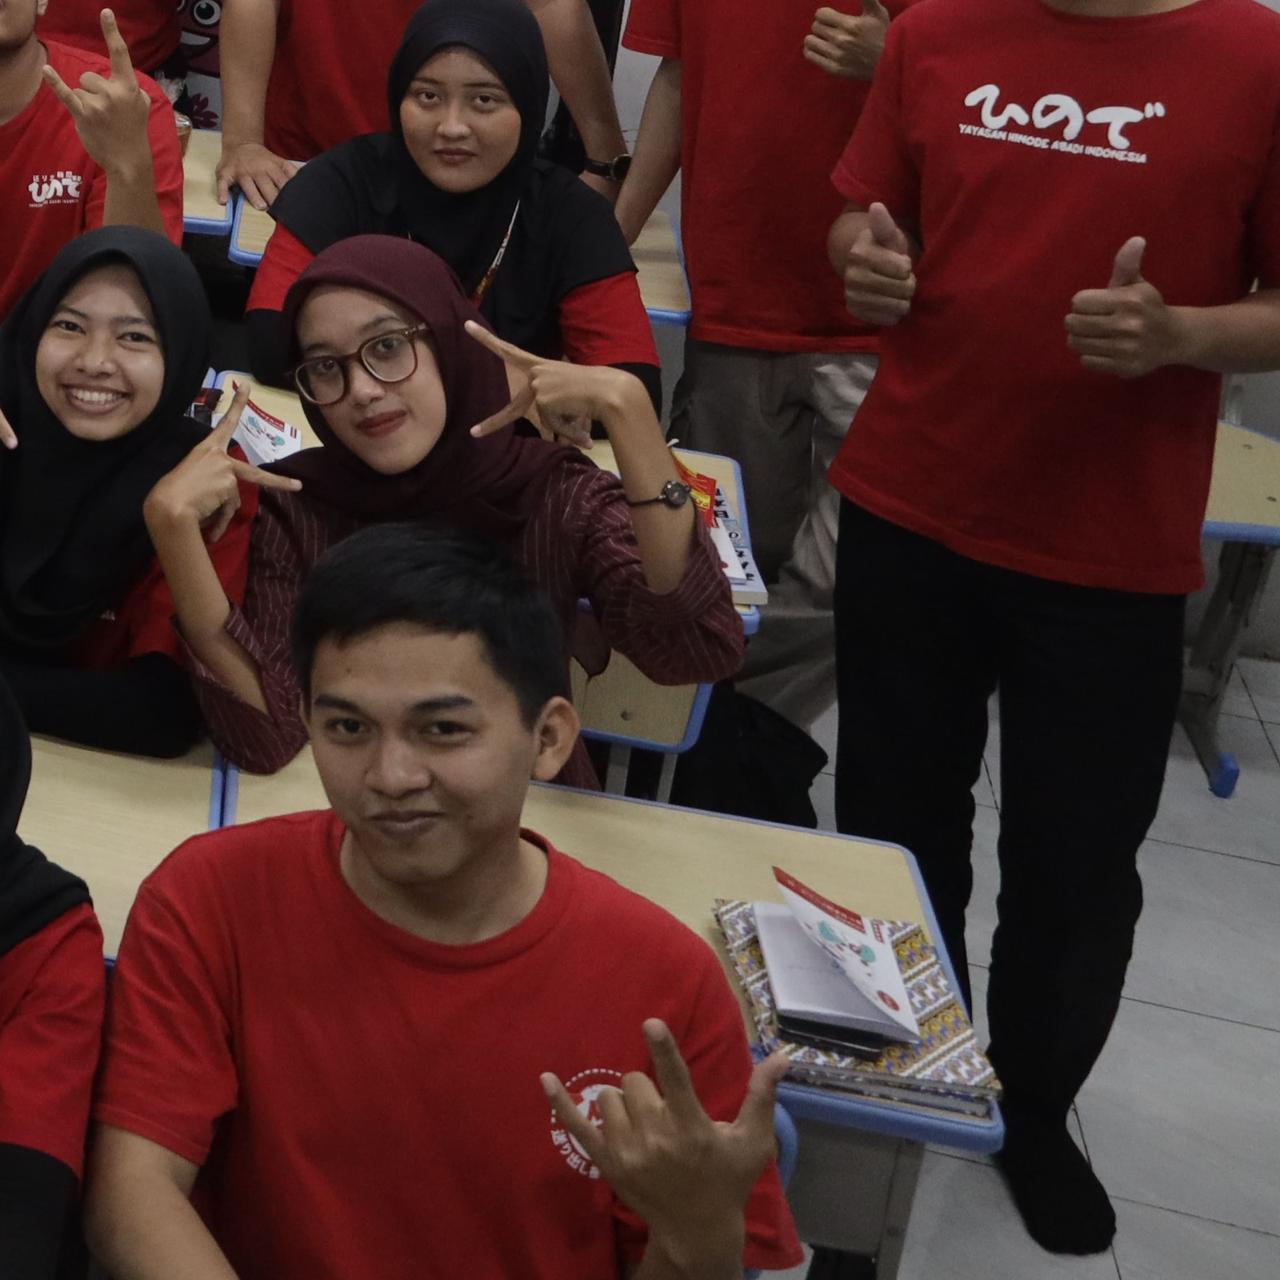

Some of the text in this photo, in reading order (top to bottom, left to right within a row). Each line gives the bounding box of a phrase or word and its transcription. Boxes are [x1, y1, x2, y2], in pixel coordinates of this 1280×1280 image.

[958, 123, 1148, 164] YAYASAN HINODE ABADI INDONESIA
[964, 84, 1166, 150] ひので
